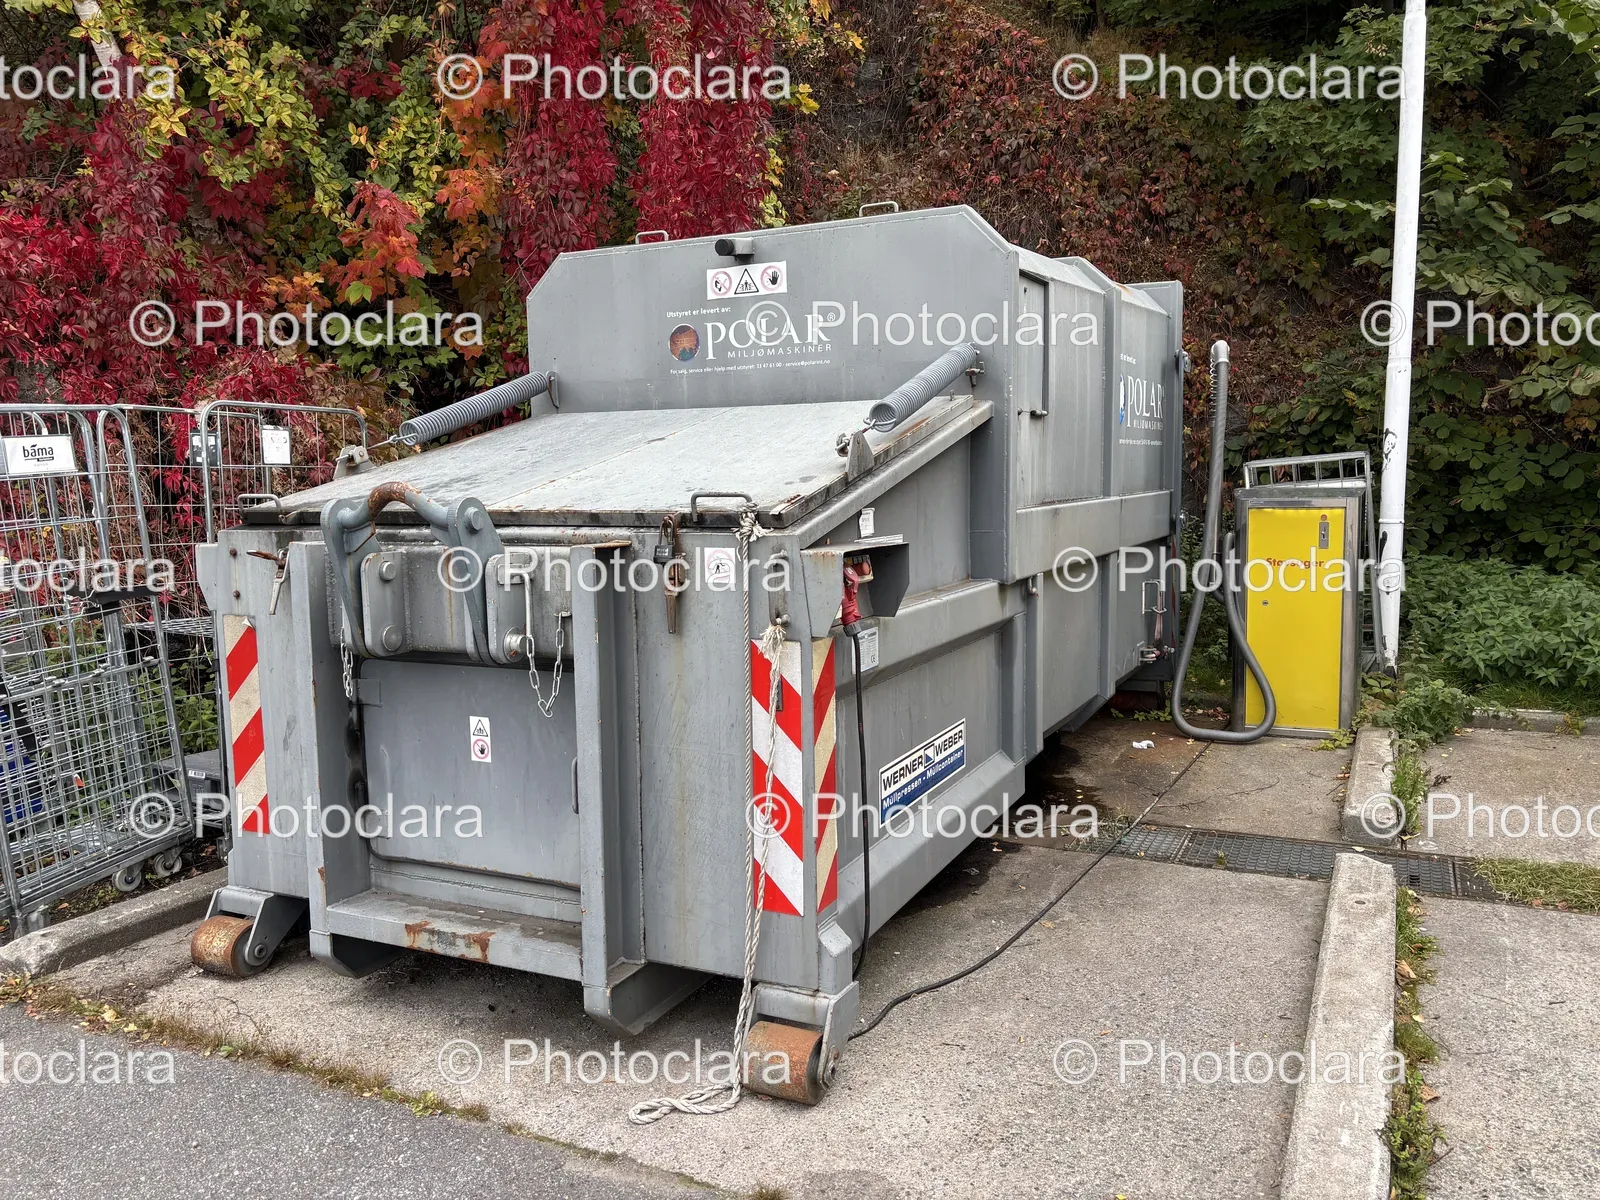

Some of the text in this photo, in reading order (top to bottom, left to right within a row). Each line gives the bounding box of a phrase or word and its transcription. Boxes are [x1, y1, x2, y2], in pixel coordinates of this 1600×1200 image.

[666, 310, 691, 318] Utstyret
[700, 307, 720, 315] levert
[727, 343, 832, 358] MILJØMASKINER
[714, 365, 725, 373] hjelp
[882, 729, 963, 791] WERNER WEBER
[882, 778, 922, 810] Müllpressen
[926, 750, 964, 780] Müllcontainer
